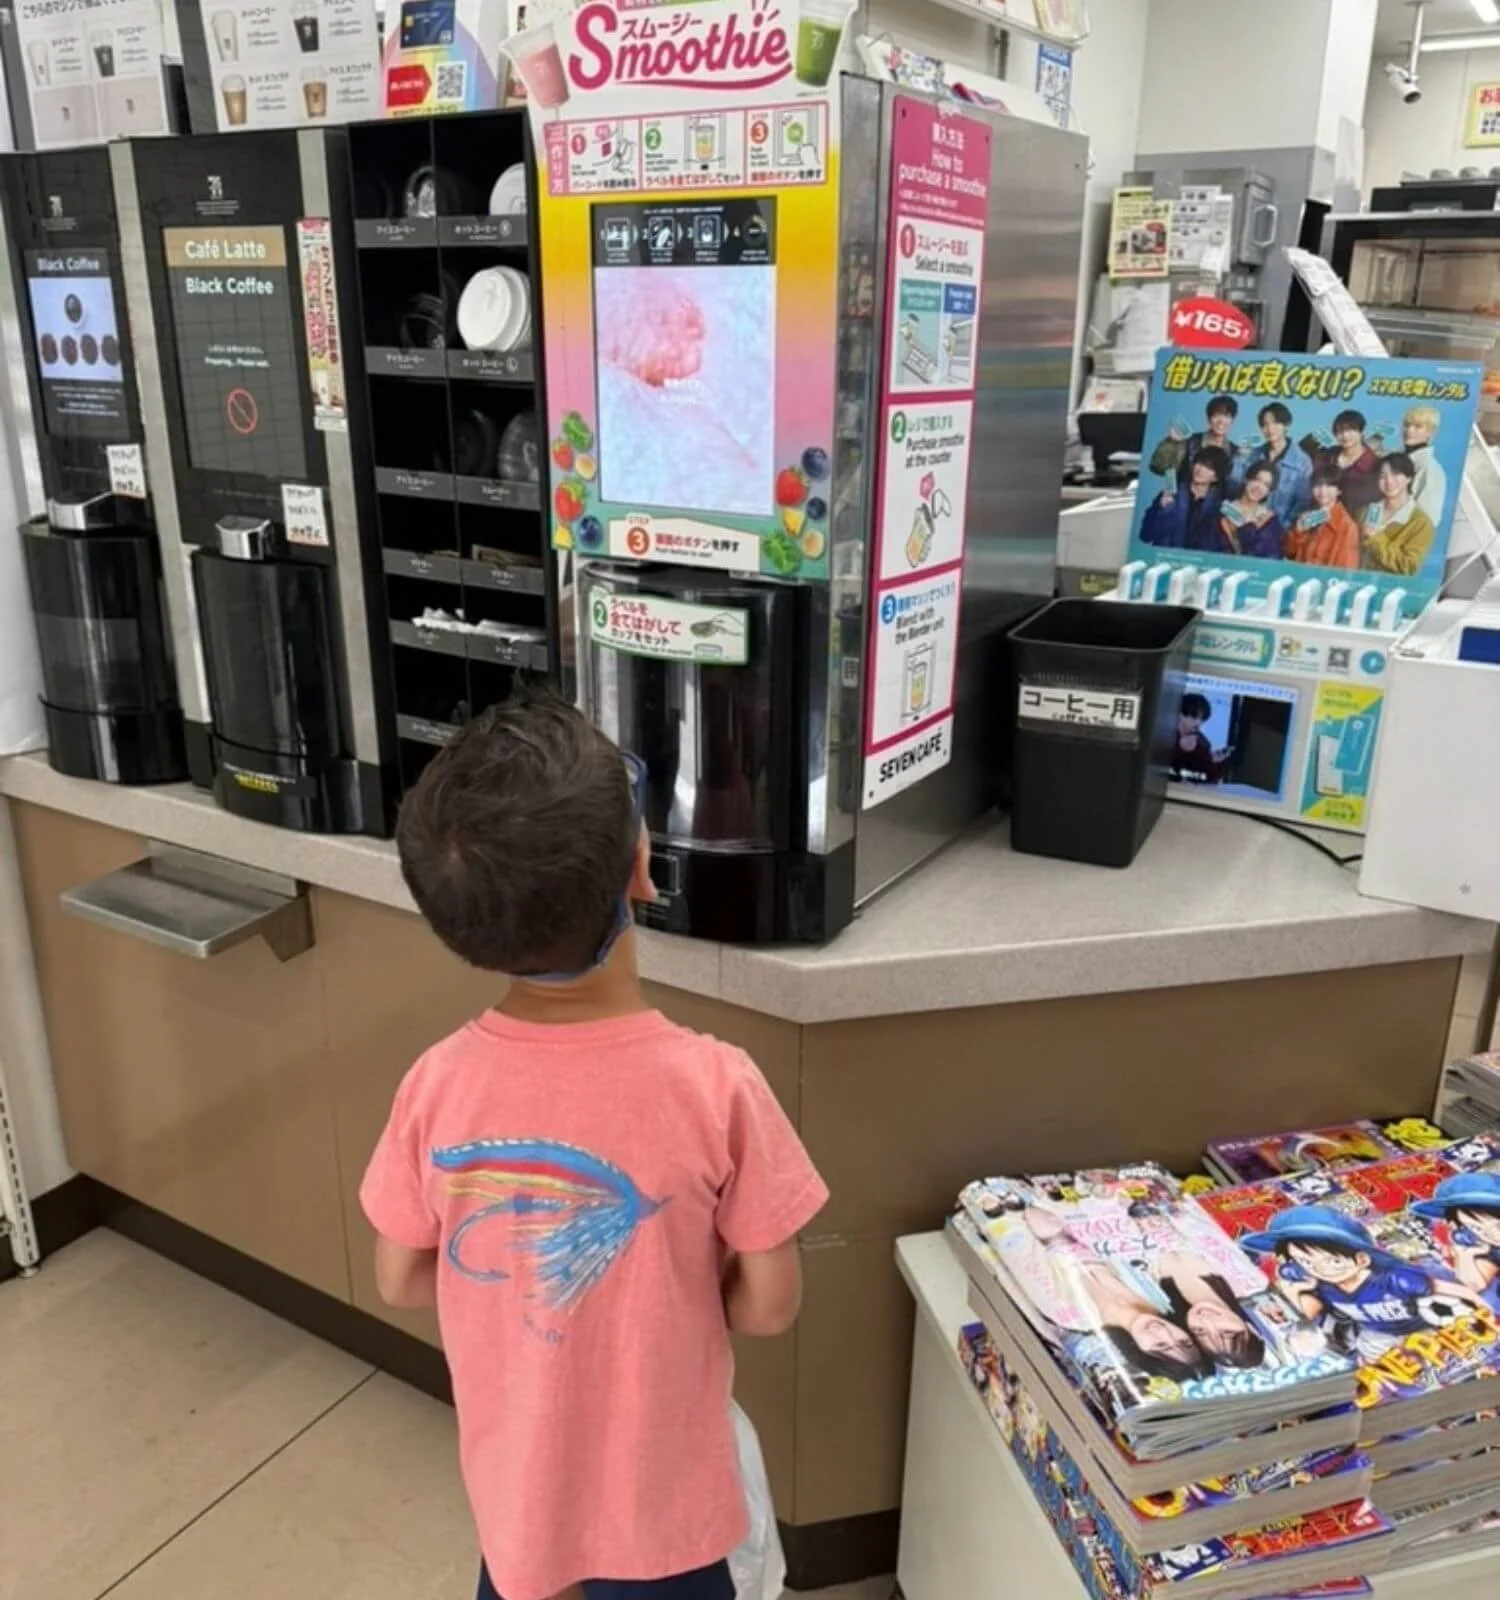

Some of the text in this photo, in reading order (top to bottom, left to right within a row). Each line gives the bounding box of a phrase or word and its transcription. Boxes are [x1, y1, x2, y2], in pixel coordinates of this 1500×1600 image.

[621, 14, 703, 40] スムージー
[568, 4, 790, 90] Smoothie
[185, 240, 266, 259] Café Latte
[37, 257, 99, 271] Black Coffee
[185, 277, 274, 294] Black Coffee
[1165, 355, 1363, 400] 借りれば良くない?
[655, 532, 741, 553] 画面のボタンを押す
[611, 597, 648, 616] ラベルを
[611, 611, 681, 635] 全てはがして
[611, 626, 670, 646] カップをセット
[1023, 689, 1135, 721] コーヒー用
[879, 748, 917, 783] SEVEN
